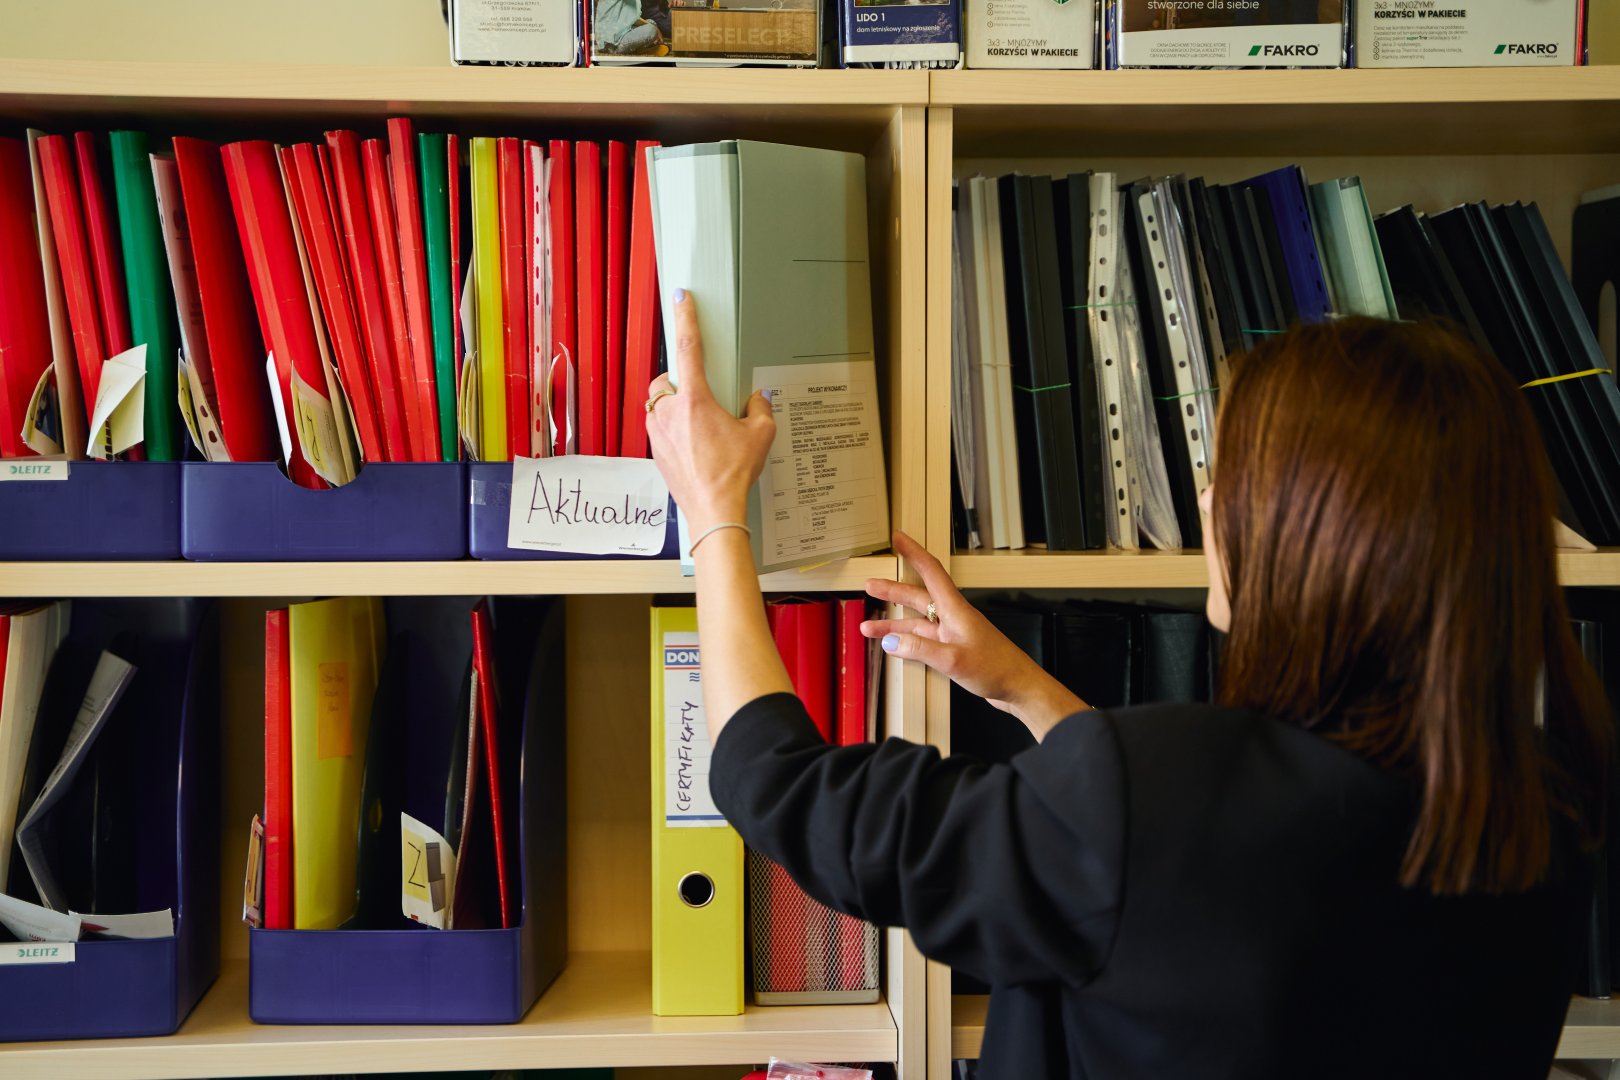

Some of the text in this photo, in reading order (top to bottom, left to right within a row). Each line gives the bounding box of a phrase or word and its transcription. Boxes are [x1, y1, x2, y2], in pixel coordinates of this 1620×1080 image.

[1147, 0, 1260, 9] stworzone dla siebie
[1374, 1, 1388, 10] 3x3
[856, 12, 886, 22] LIDO 1
[1374, 9, 1467, 18] KORZYŚCI W PAKIECIE
[871, 25, 901, 33] letniskowy
[987, 38, 1000, 47] 3x3
[987, 46, 1079, 56] KORZYŚCI W PAKIECIE
[1264, 44, 1319, 56] FAKRO
[1508, 43, 1558, 54] FAKRO
[18, 465, 52, 475] LEITZ
[527, 470, 666, 527] Aktualne
[676, 701, 699, 812] CERTYFIKATY
[25, 947, 59, 957] LEITZ
